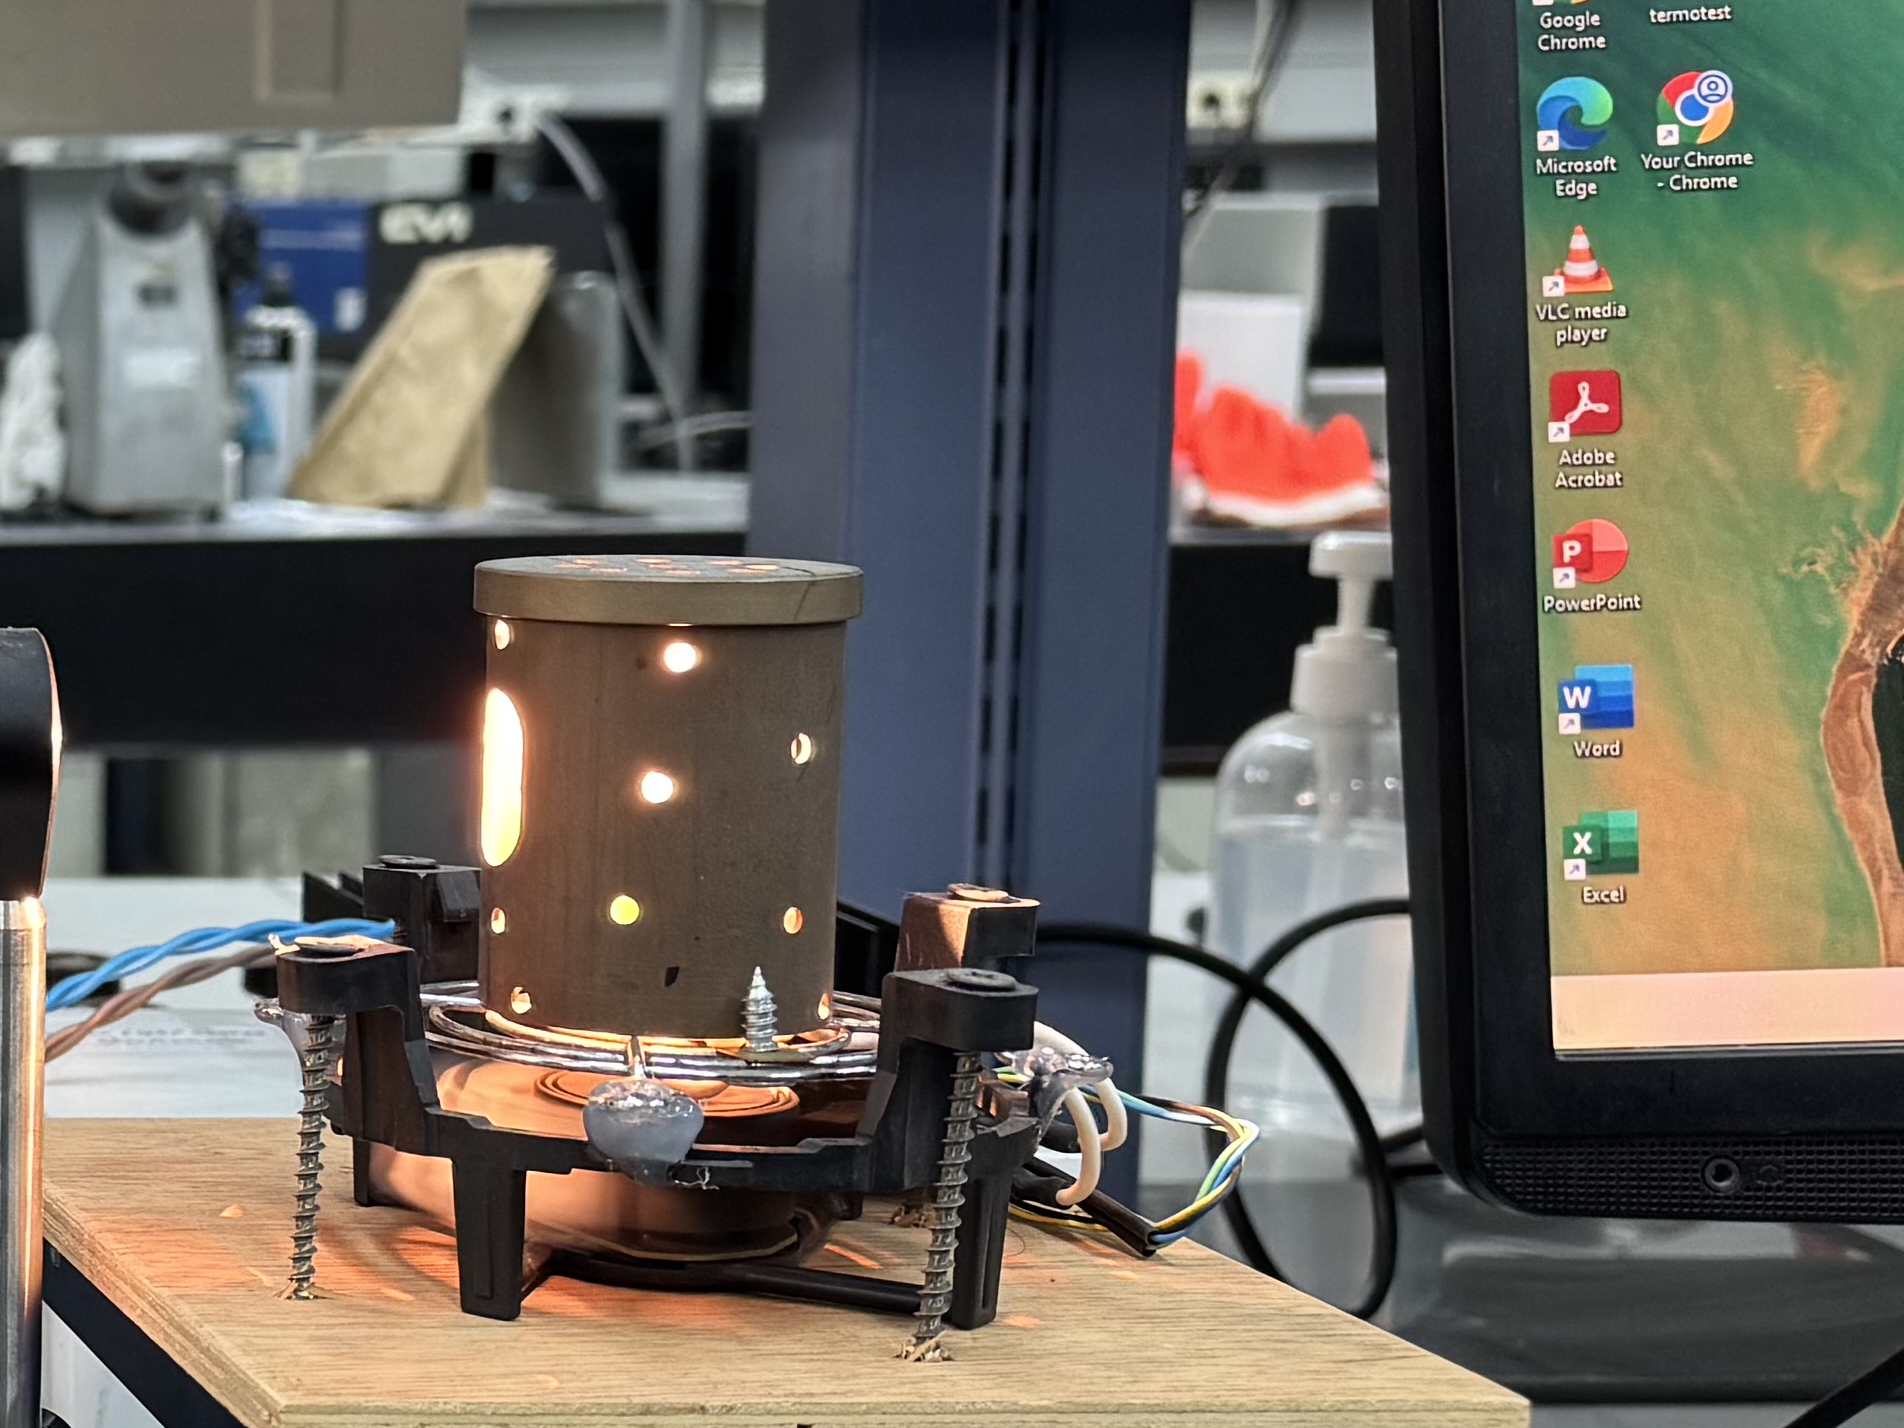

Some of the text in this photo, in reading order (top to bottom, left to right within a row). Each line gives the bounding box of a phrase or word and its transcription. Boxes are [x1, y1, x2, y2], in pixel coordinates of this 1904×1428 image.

[1540, 9, 1601, 32] Google
[1649, 4, 1733, 23] termotest
[1538, 33, 1607, 51] Chrome
[1536, 155, 1618, 175] Microsoft
[1642, 150, 1754, 170] Your Chrome
[1555, 178, 1598, 200] Edge
[1669, 174, 1738, 192] Chrome
[1535, 301, 1627, 321] VLC media
[1556, 325, 1608, 347] player
[1558, 448, 1616, 466] Adobe
[1555, 470, 1623, 489] Acrobat
[1543, 594, 1642, 613] PowerPoint
[1573, 740, 1622, 758] Word
[1582, 885, 1626, 905] Excel
